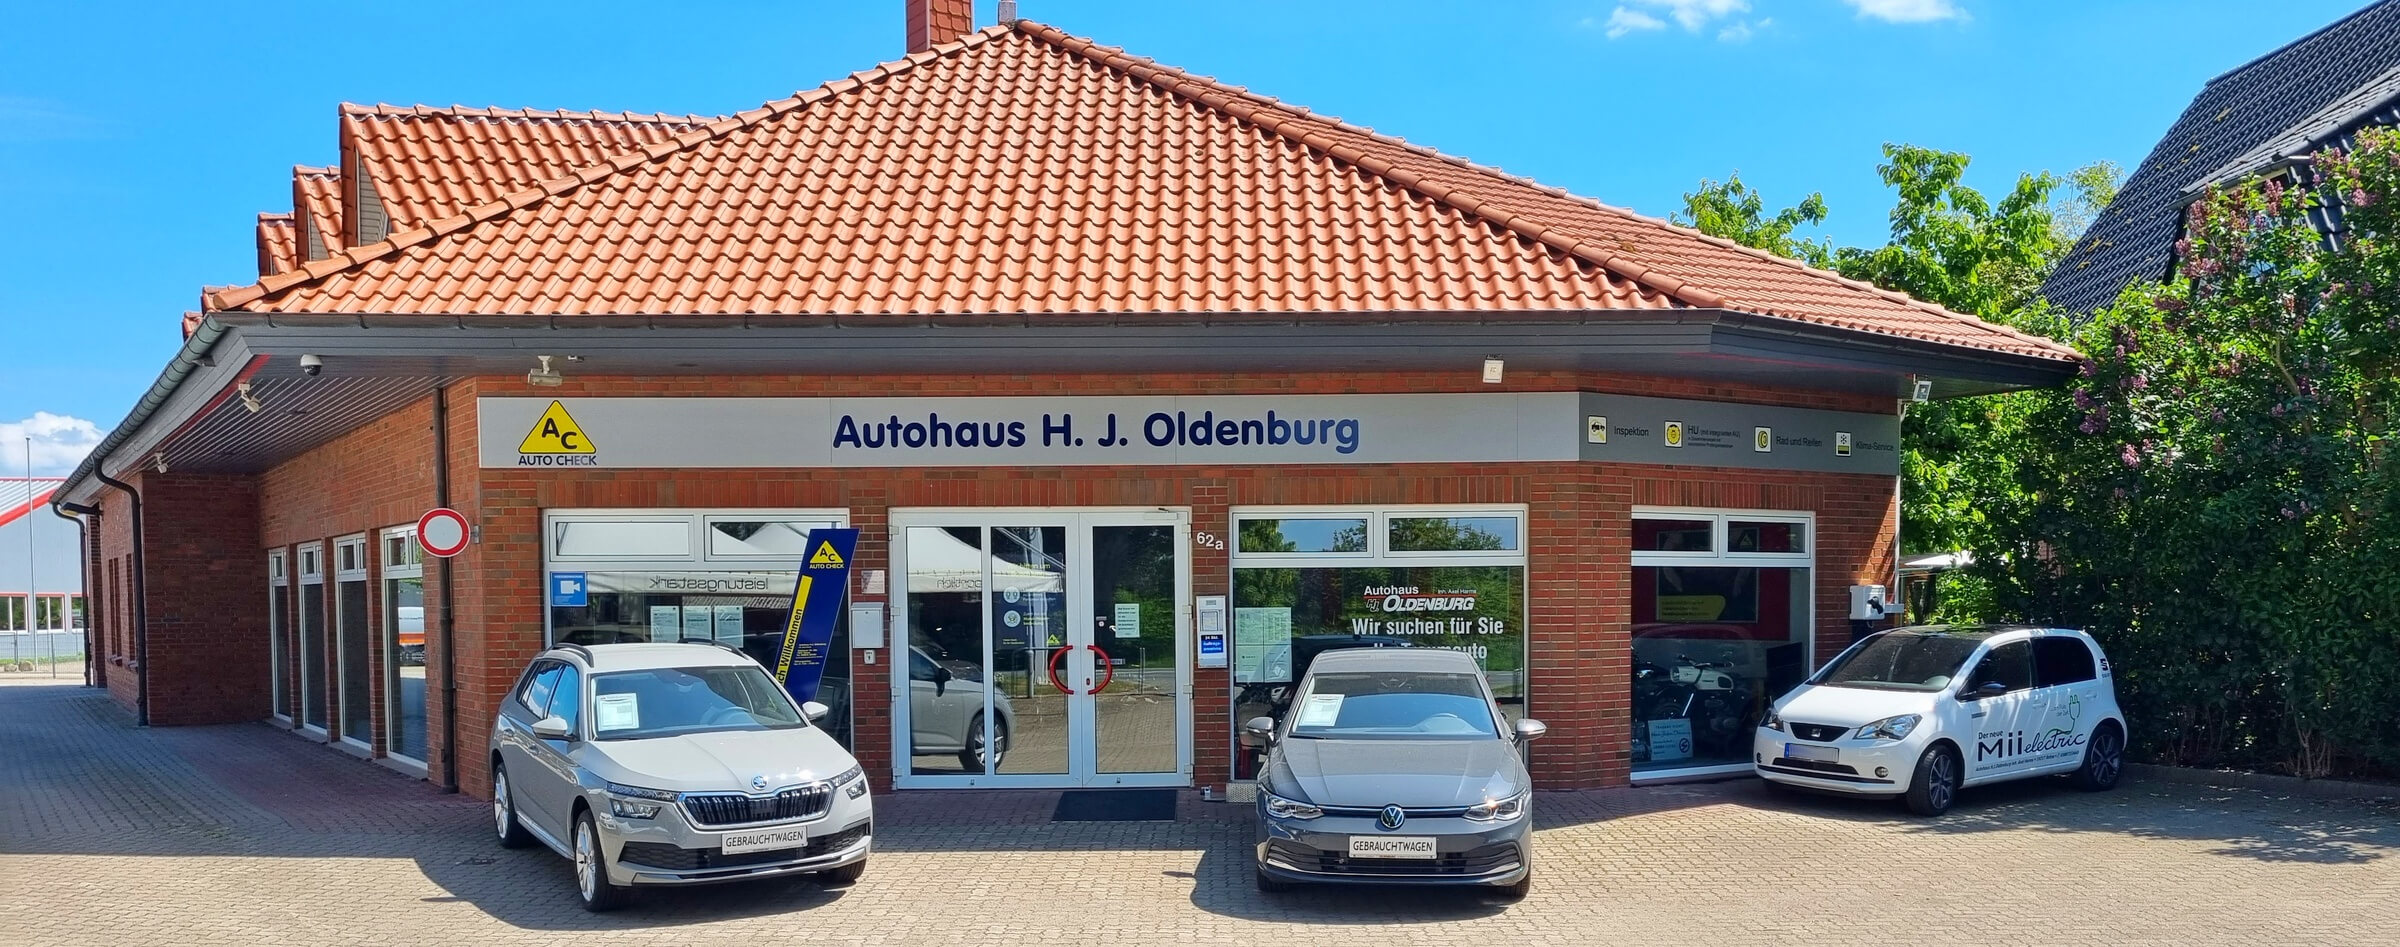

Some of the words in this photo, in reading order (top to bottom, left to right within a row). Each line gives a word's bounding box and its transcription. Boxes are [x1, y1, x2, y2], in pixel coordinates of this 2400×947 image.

[832, 413, 1026, 449] Autohaus
[1042, 413, 1083, 448] H.
[1097, 413, 1128, 448] J.
[1143, 410, 1360, 455] Oldenburg
[1614, 425, 1649, 438] Inspektion
[1688, 425, 1699, 435] HU
[1776, 435, 1789, 446] Rad
[1790, 437, 1802, 446] und
[518, 455, 553, 466] AUTO
[556, 455, 598, 466] CHECK
[1197, 531, 1224, 550] 62a
[1363, 585, 1419, 596] Autohaus
[1383, 594, 1476, 613] OLDENBURG
[1352, 618, 1381, 636] Wir
[1386, 617, 1444, 636] suchen
[1450, 617, 1473, 635] für
[1478, 616, 1504, 635] Sie
[780, 608, 803, 667] Willkommen
[1978, 731, 1989, 740] Der
[1989, 730, 2004, 739] neue
[1977, 730, 2023, 762] Mii
[2023, 729, 2086, 754] electric
[725, 830, 804, 847] GEBRAUCHTWAGEN
[1352, 840, 1433, 852] GEBRAUCHTWAGEN
